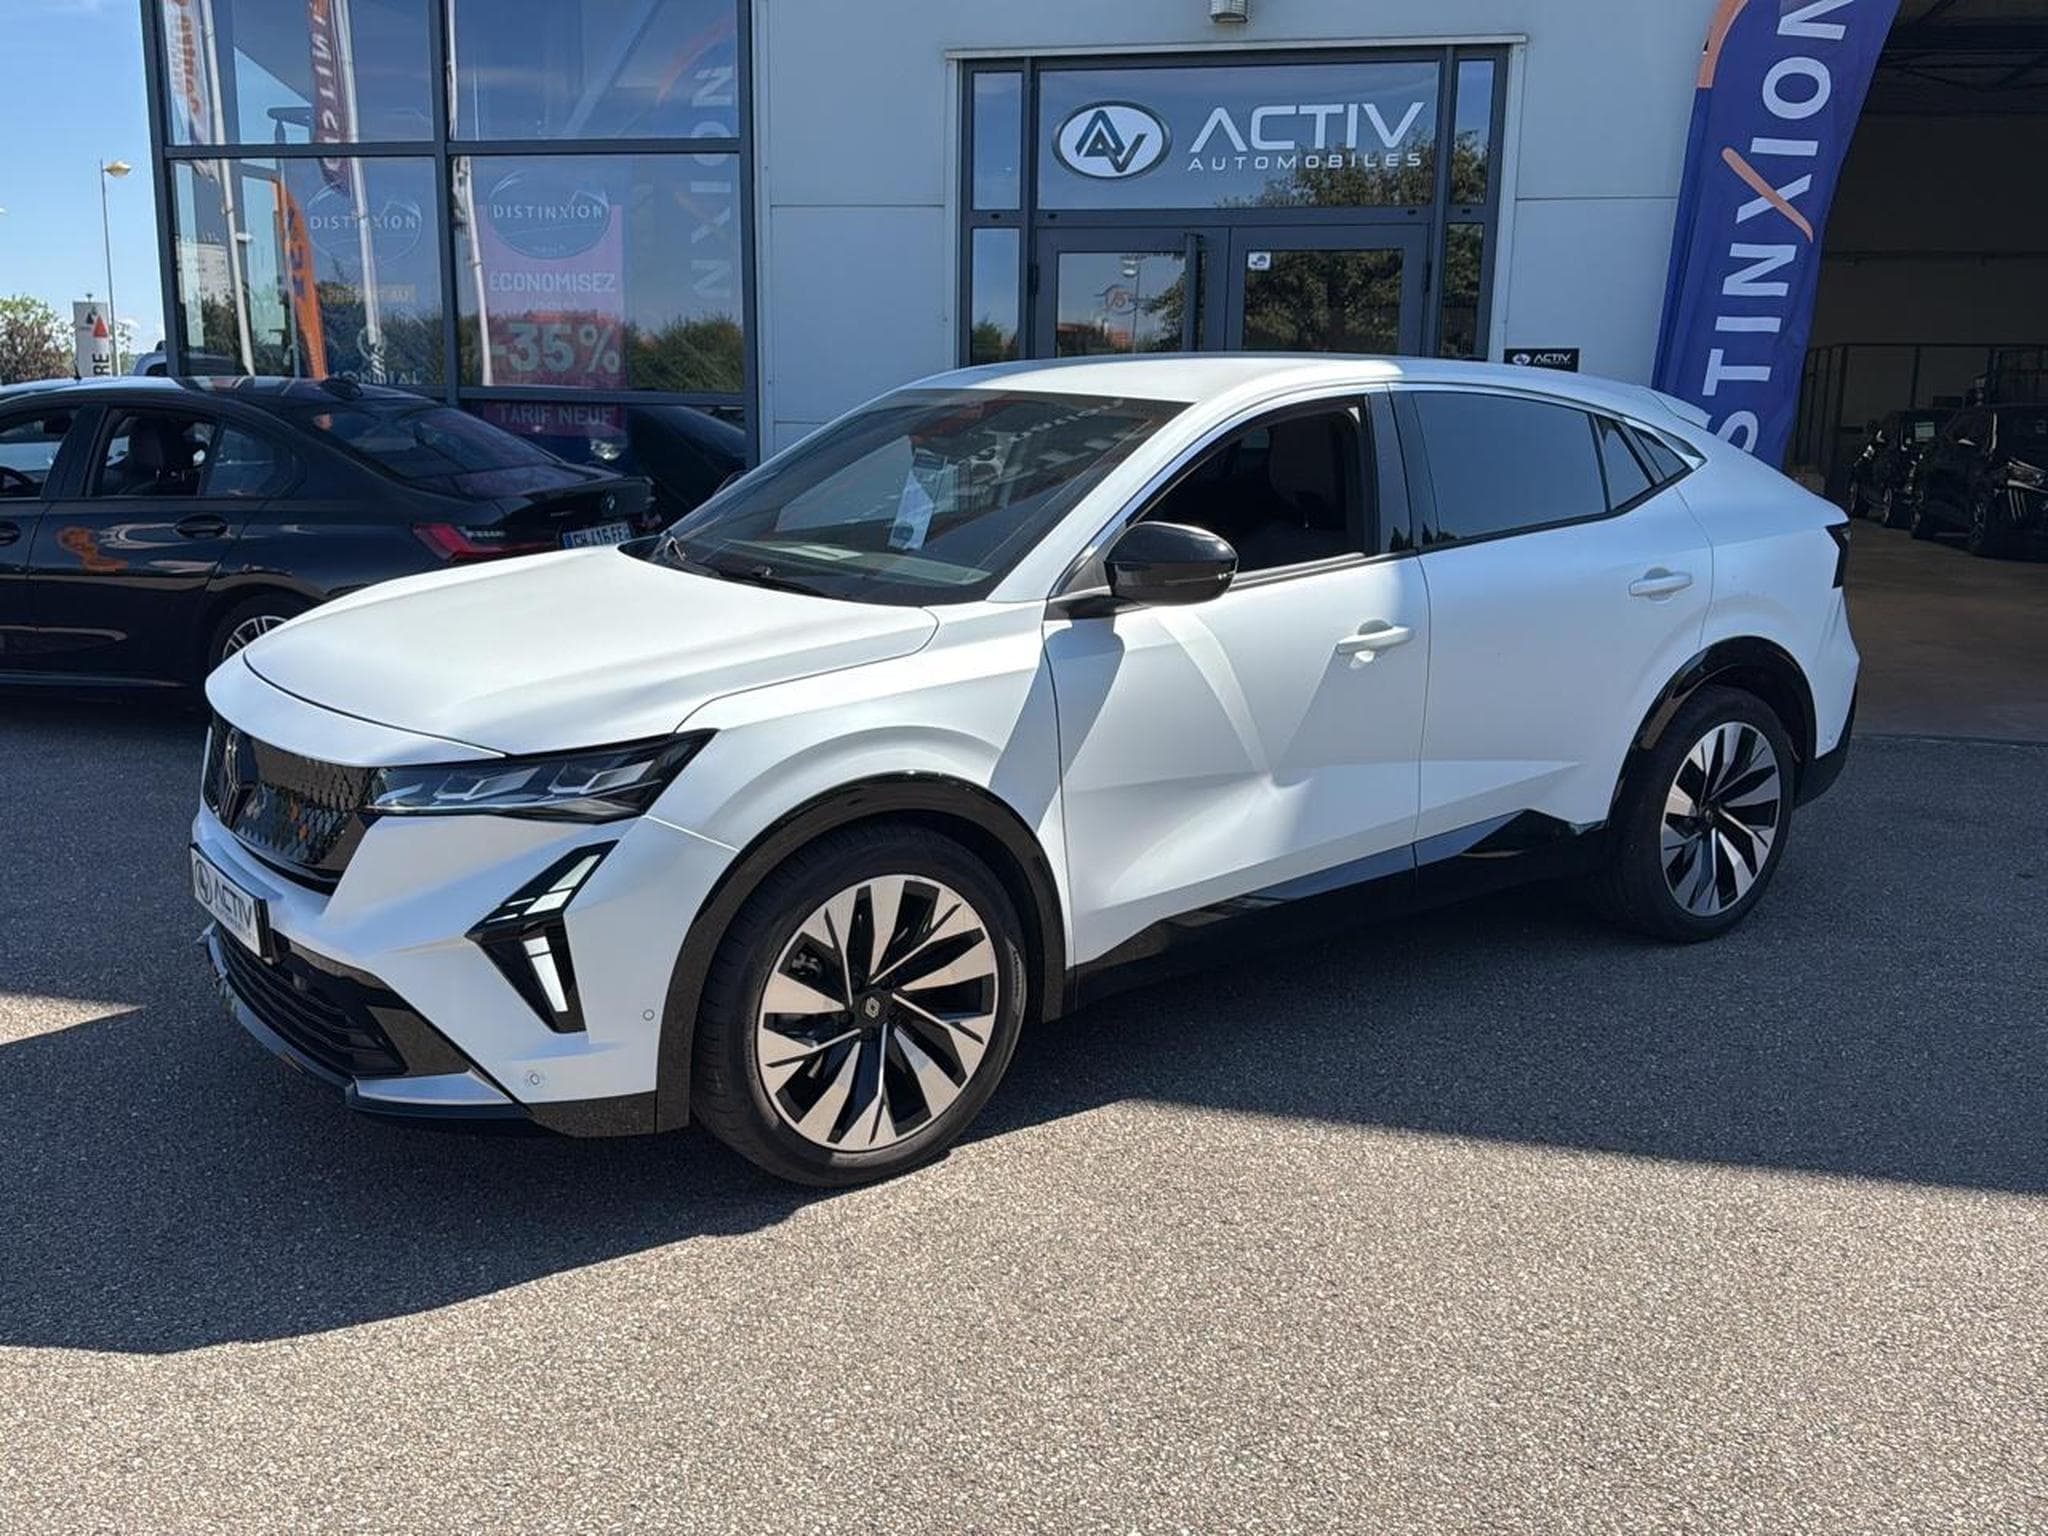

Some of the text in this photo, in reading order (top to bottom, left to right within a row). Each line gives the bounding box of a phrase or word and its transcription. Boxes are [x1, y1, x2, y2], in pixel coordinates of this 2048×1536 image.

[1189, 102, 1425, 153] ACTIV
[1187, 152, 1422, 172] AUTOMOBILES
[493, 203, 603, 219] DISTINXION
[309, 214, 417, 230] DISTIXION
[1533, 352, 1572, 364] ACTIV
[499, 403, 616, 425] TARIF NEUF
[214, 878, 252, 930] ACTIV
